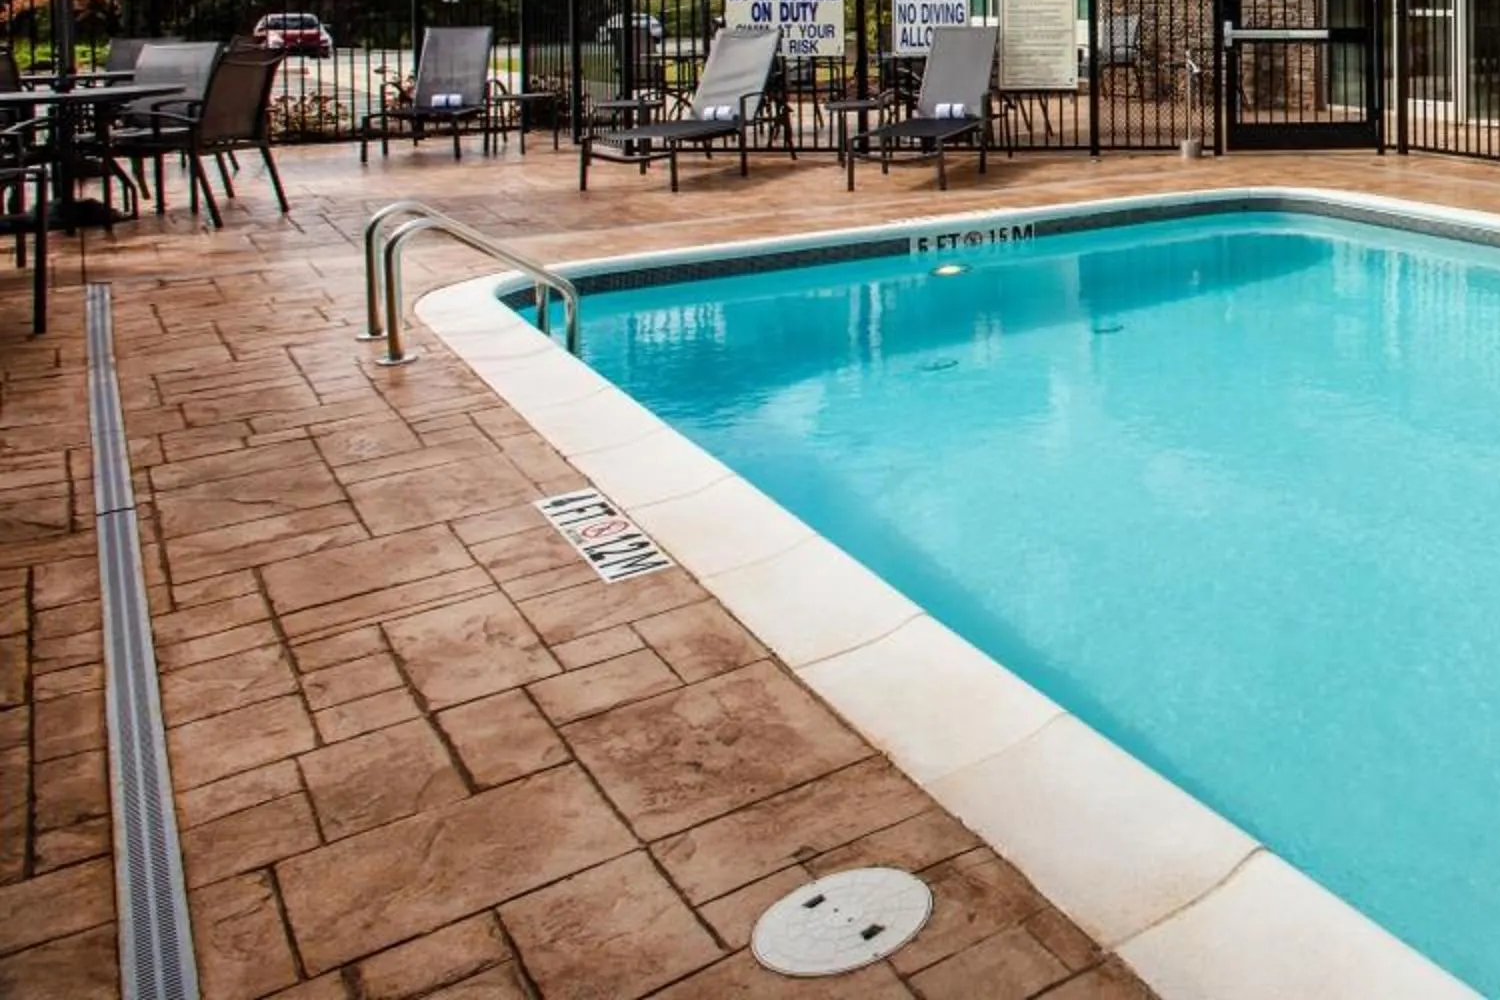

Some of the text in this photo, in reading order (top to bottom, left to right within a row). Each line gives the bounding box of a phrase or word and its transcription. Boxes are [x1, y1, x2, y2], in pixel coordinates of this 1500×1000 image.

[751, 2, 818, 21] ON DUTY
[897, 3, 964, 24] NO DIVING
[799, 24, 835, 38] YOUR
[789, 40, 818, 53] RISK
[936, 233, 960, 250] FT
[550, 501, 618, 526] FT
